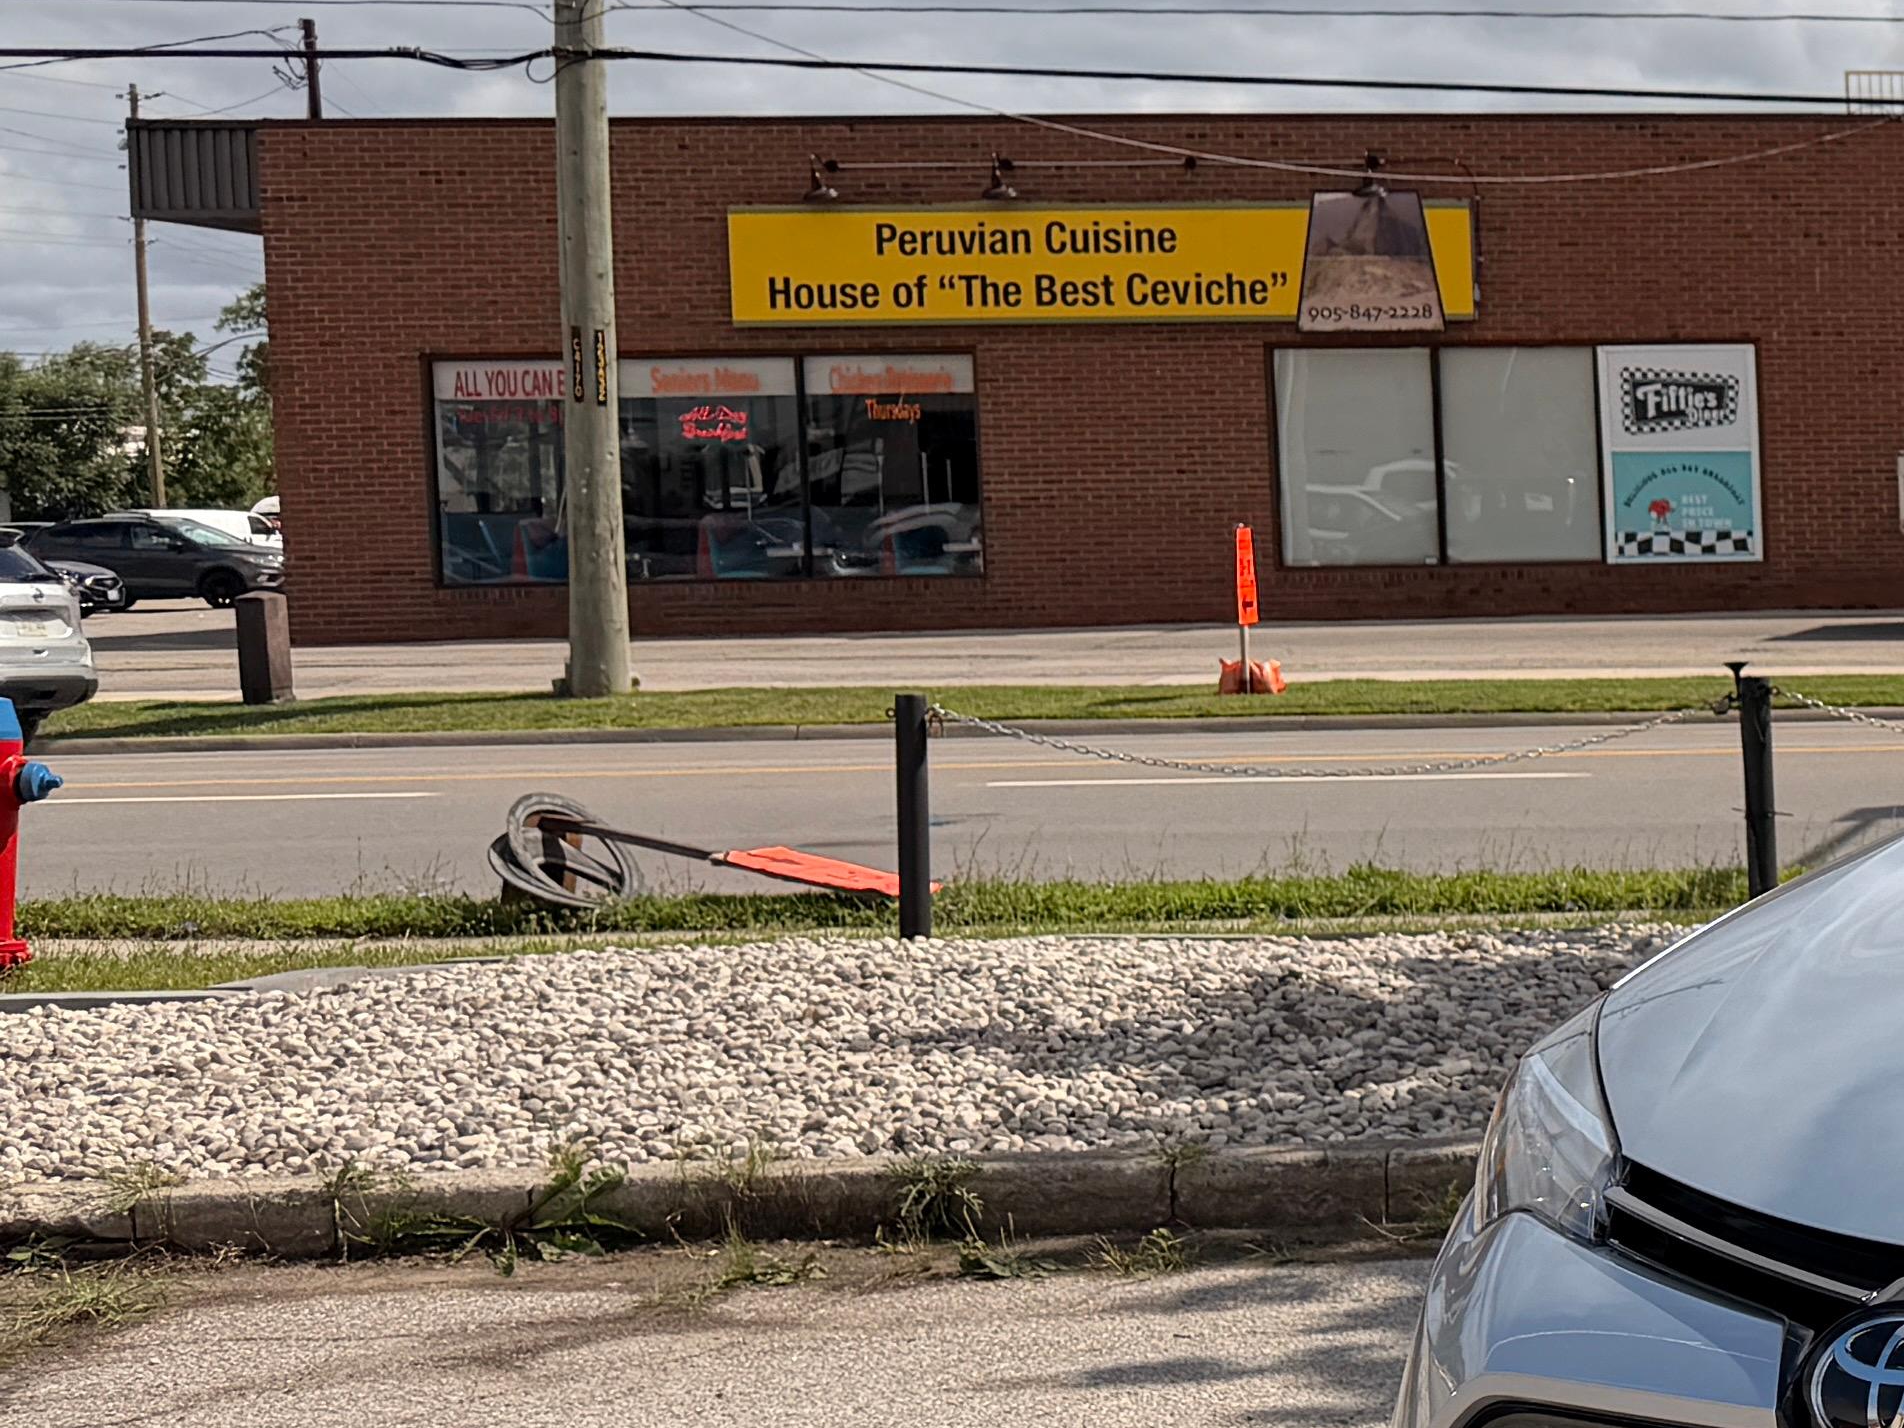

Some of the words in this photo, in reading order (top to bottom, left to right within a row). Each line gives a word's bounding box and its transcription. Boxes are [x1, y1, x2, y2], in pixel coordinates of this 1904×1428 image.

[875, 222, 1032, 256] Peruvian
[1044, 221, 1178, 254] Cuisine
[768, 276, 880, 309] House
[892, 274, 927, 308] of
[938, 274, 1022, 307] “The
[1034, 274, 1115, 307] Best
[1126, 272, 1288, 307] Ceviche”
[1307, 305, 1433, 323] 905-847-2228
[454, 370, 482, 397] ALL
[485, 370, 518, 397] YOU
[521, 370, 552, 397] CAN
[865, 398, 921, 425] Thursdays
